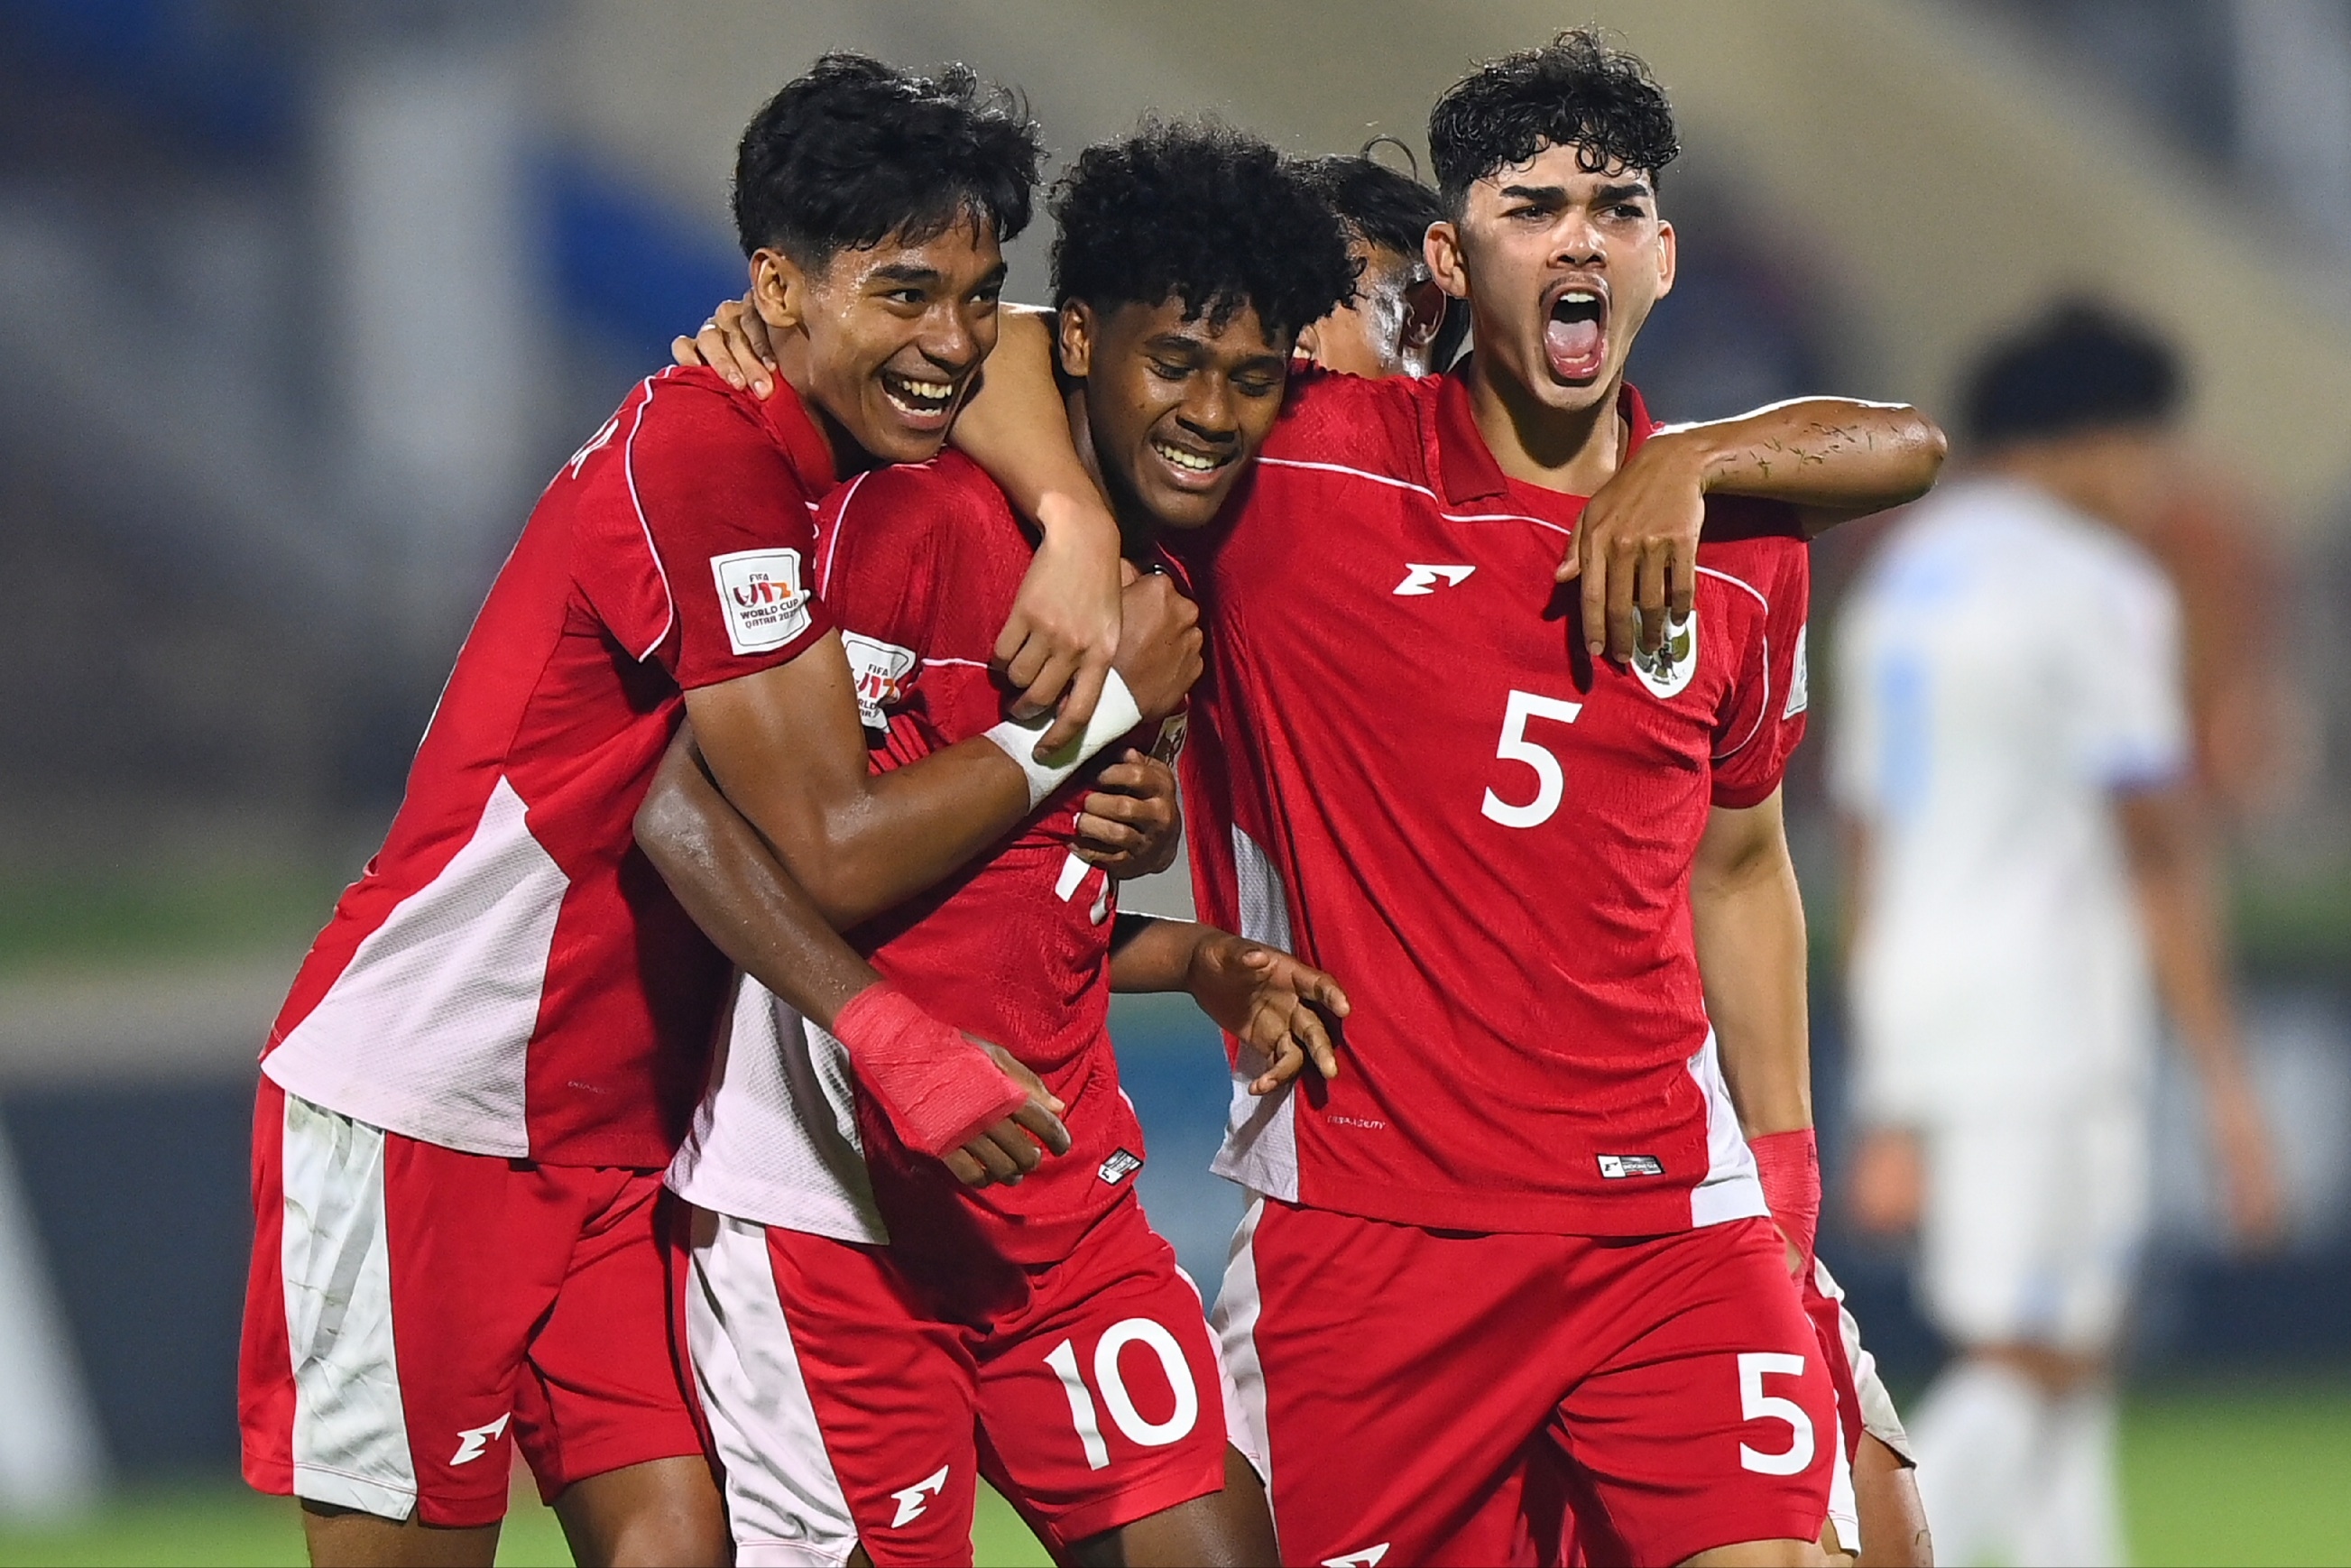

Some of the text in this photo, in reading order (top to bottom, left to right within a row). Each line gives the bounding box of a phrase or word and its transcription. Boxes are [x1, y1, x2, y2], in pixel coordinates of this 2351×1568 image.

[749, 573, 770, 583] FIFA
[733, 582, 791, 608] U17
[740, 598, 799, 620] WORLD CUP
[745, 610, 797, 630] QATAR 202
[868, 663, 889, 677] FIFA
[1480, 689, 1583, 828] 5
[1042, 1317, 1199, 1471] 10
[1737, 1351, 1815, 1476] 5
